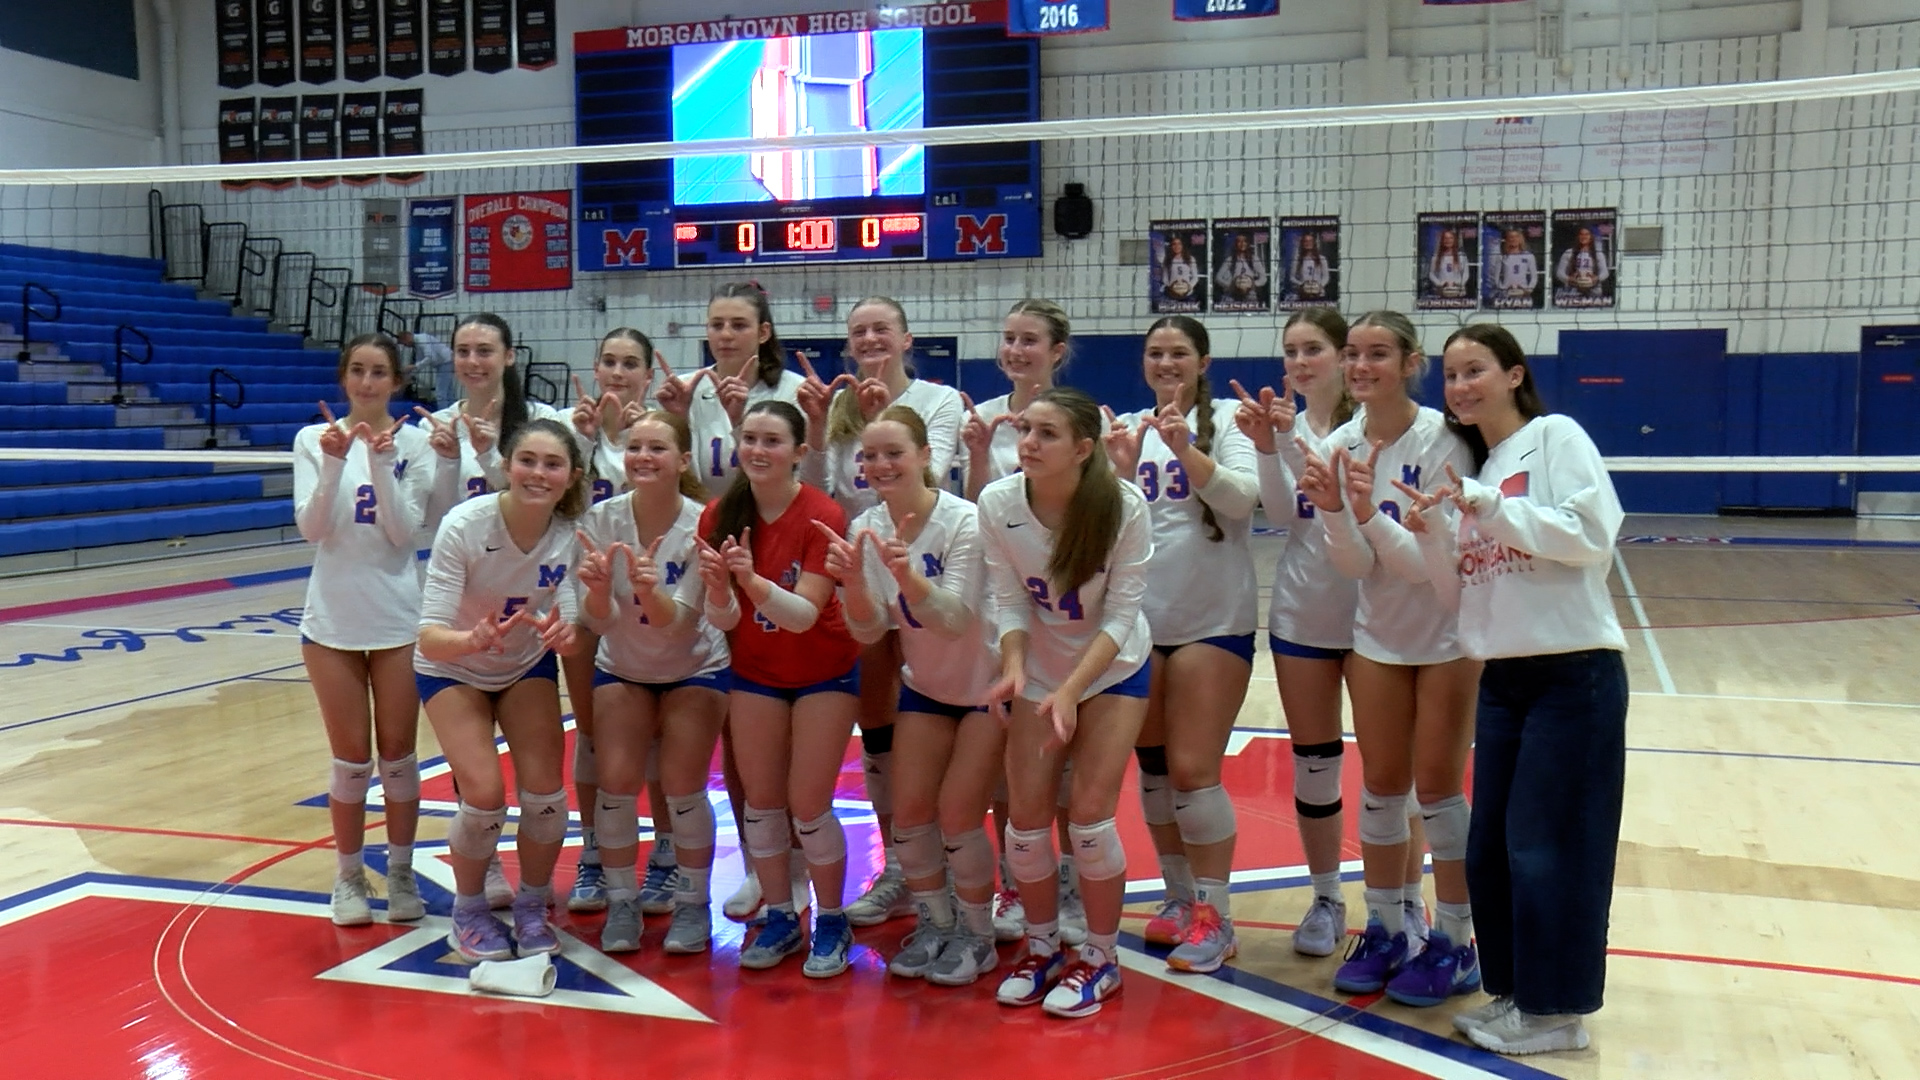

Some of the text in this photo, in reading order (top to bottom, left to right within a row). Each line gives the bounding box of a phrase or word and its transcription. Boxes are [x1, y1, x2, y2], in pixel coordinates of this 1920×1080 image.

[626, 4, 977, 48] MORGANTOWN HIGH SCHOOL
[1039, 5, 1079, 29] 2016
[467, 196, 514, 223] OVERALL
[518, 195, 569, 220] CHAMPION
[603, 228, 649, 267] M
[738, 223, 756, 253] 0
[787, 220, 835, 250] 1:00
[861, 217, 880, 248] 0
[955, 213, 1008, 255] M
[1555, 297, 1612, 307] WISMAN
[1137, 460, 1190, 503] 33
[1402, 464, 1422, 490] M
[355, 483, 377, 525] 2
[537, 564, 567, 588] M
[665, 561, 688, 585] M
[1026, 576, 1084, 621] 24
